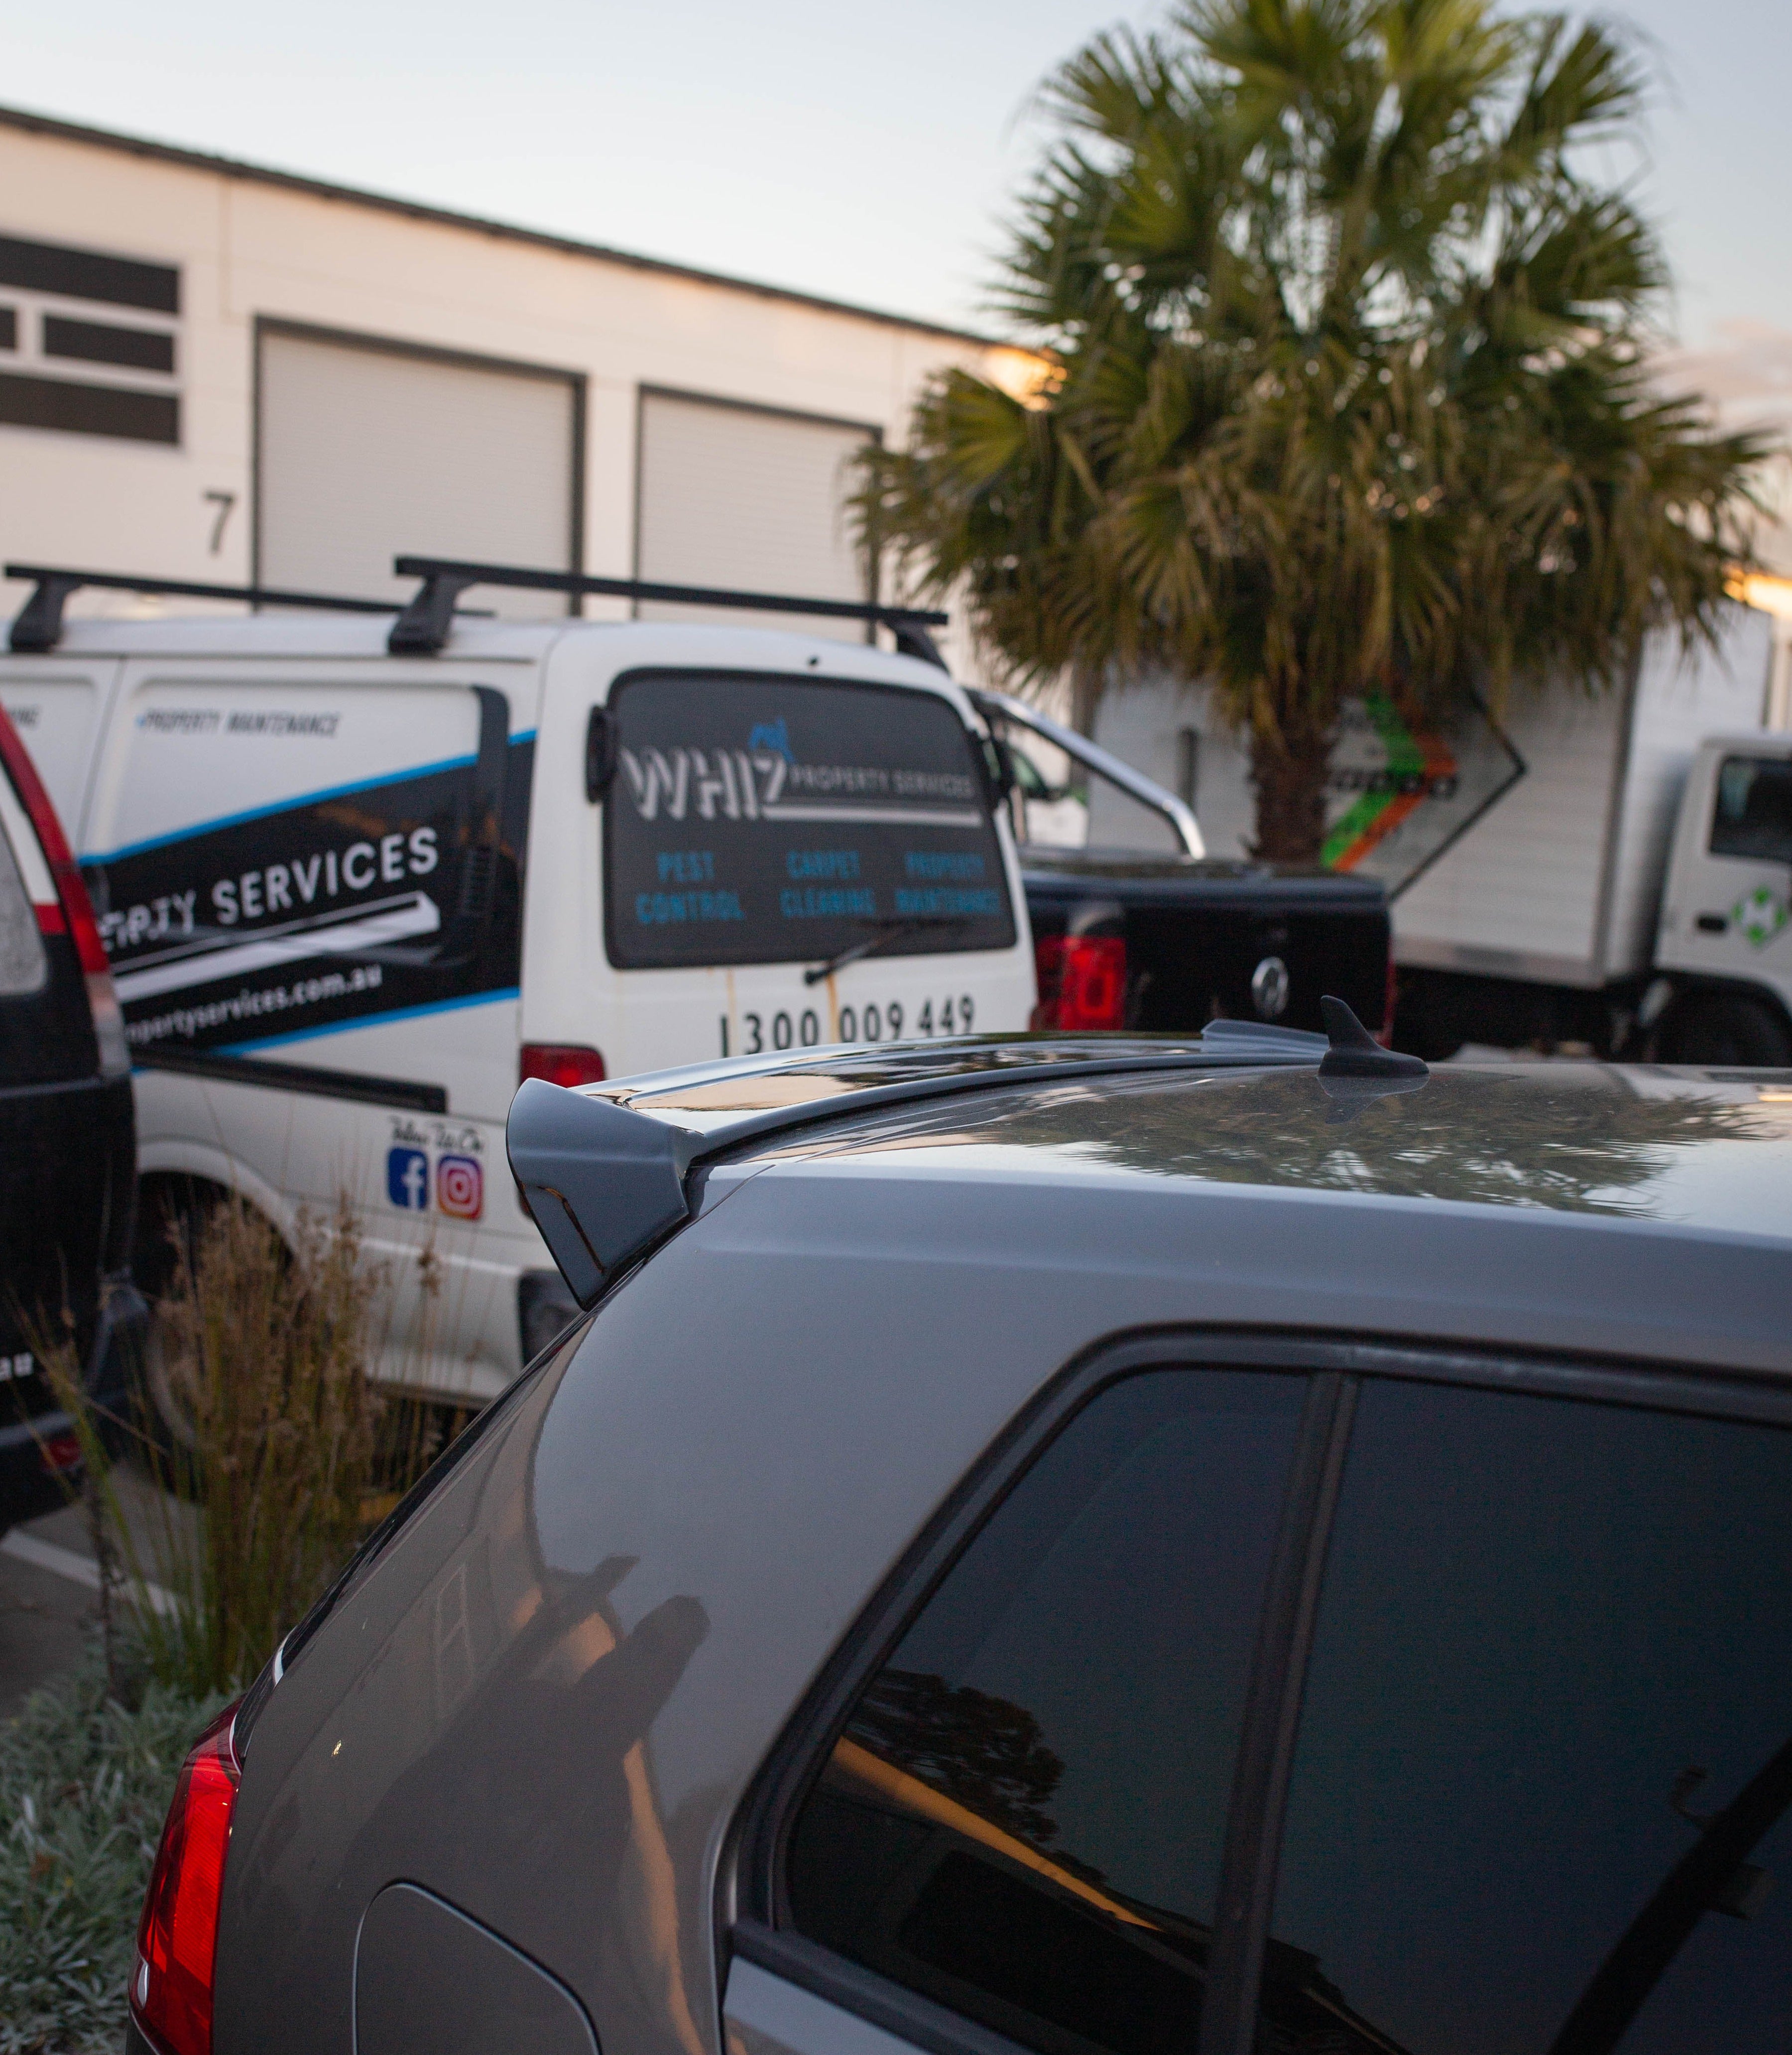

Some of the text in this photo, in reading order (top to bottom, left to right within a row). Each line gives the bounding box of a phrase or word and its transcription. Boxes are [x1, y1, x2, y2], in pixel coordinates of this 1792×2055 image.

[202, 489, 235, 554] 7
[146, 707, 341, 738] PROPERTY MAINTENANCE
[212, 827, 439, 925] SERVICES
[657, 851, 715, 883] PEST
[786, 850, 861, 880] CARPET
[635, 890, 745, 926] CONTROL
[779, 887, 877, 919] CLEANING
[719, 993, 975, 1058] 1300 009 449
